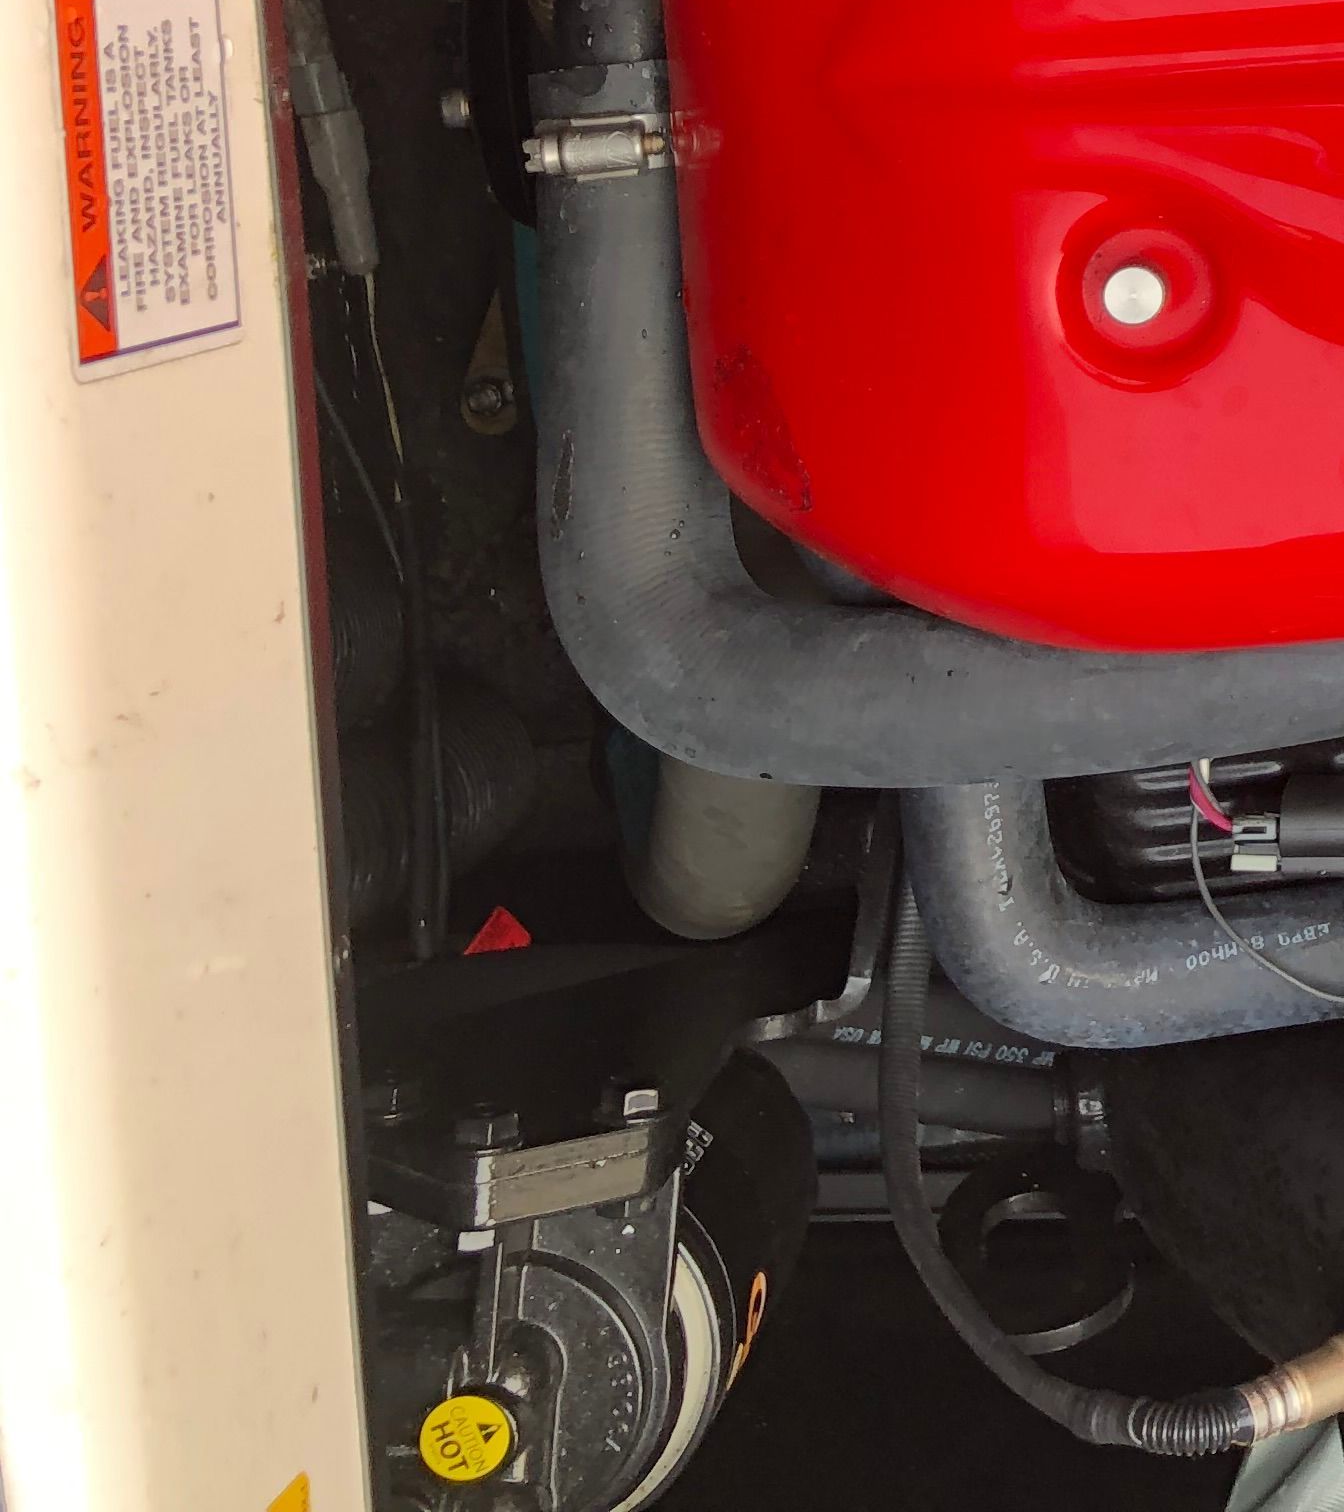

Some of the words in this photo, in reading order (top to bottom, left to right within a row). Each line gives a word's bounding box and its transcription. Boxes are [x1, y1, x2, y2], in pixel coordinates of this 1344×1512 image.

[102, 42, 117, 61] A
[104, 67, 119, 94] IS
[160, 20, 178, 106] TANKS
[177, 66, 192, 104] OR
[188, 17, 206, 98] LEAST
[66, 14, 97, 234] WARNING
[106, 99, 124, 171] FUEL
[116, 24, 139, 180] EXPLOSION
[132, 46, 152, 162] INSPECT
[193, 103, 208, 136] AT
[165, 112, 183, 180] FUEL
[180, 110, 198, 196] LEAKS
[206, 90, 227, 224] ANNUALLY
[111, 177, 132, 297] LEAKING
[126, 185, 143, 245] AND
[156, 194, 176, 304] SYSTEM
[170, 186, 191, 305] EXAMINE
[185, 201, 201, 256] FOR
[195, 141, 218, 301] CORROSION
[131, 251, 147, 312] FIRE
[431, 1420, 470, 1472] HOT
[450, 1405, 488, 1473] CAUTION
